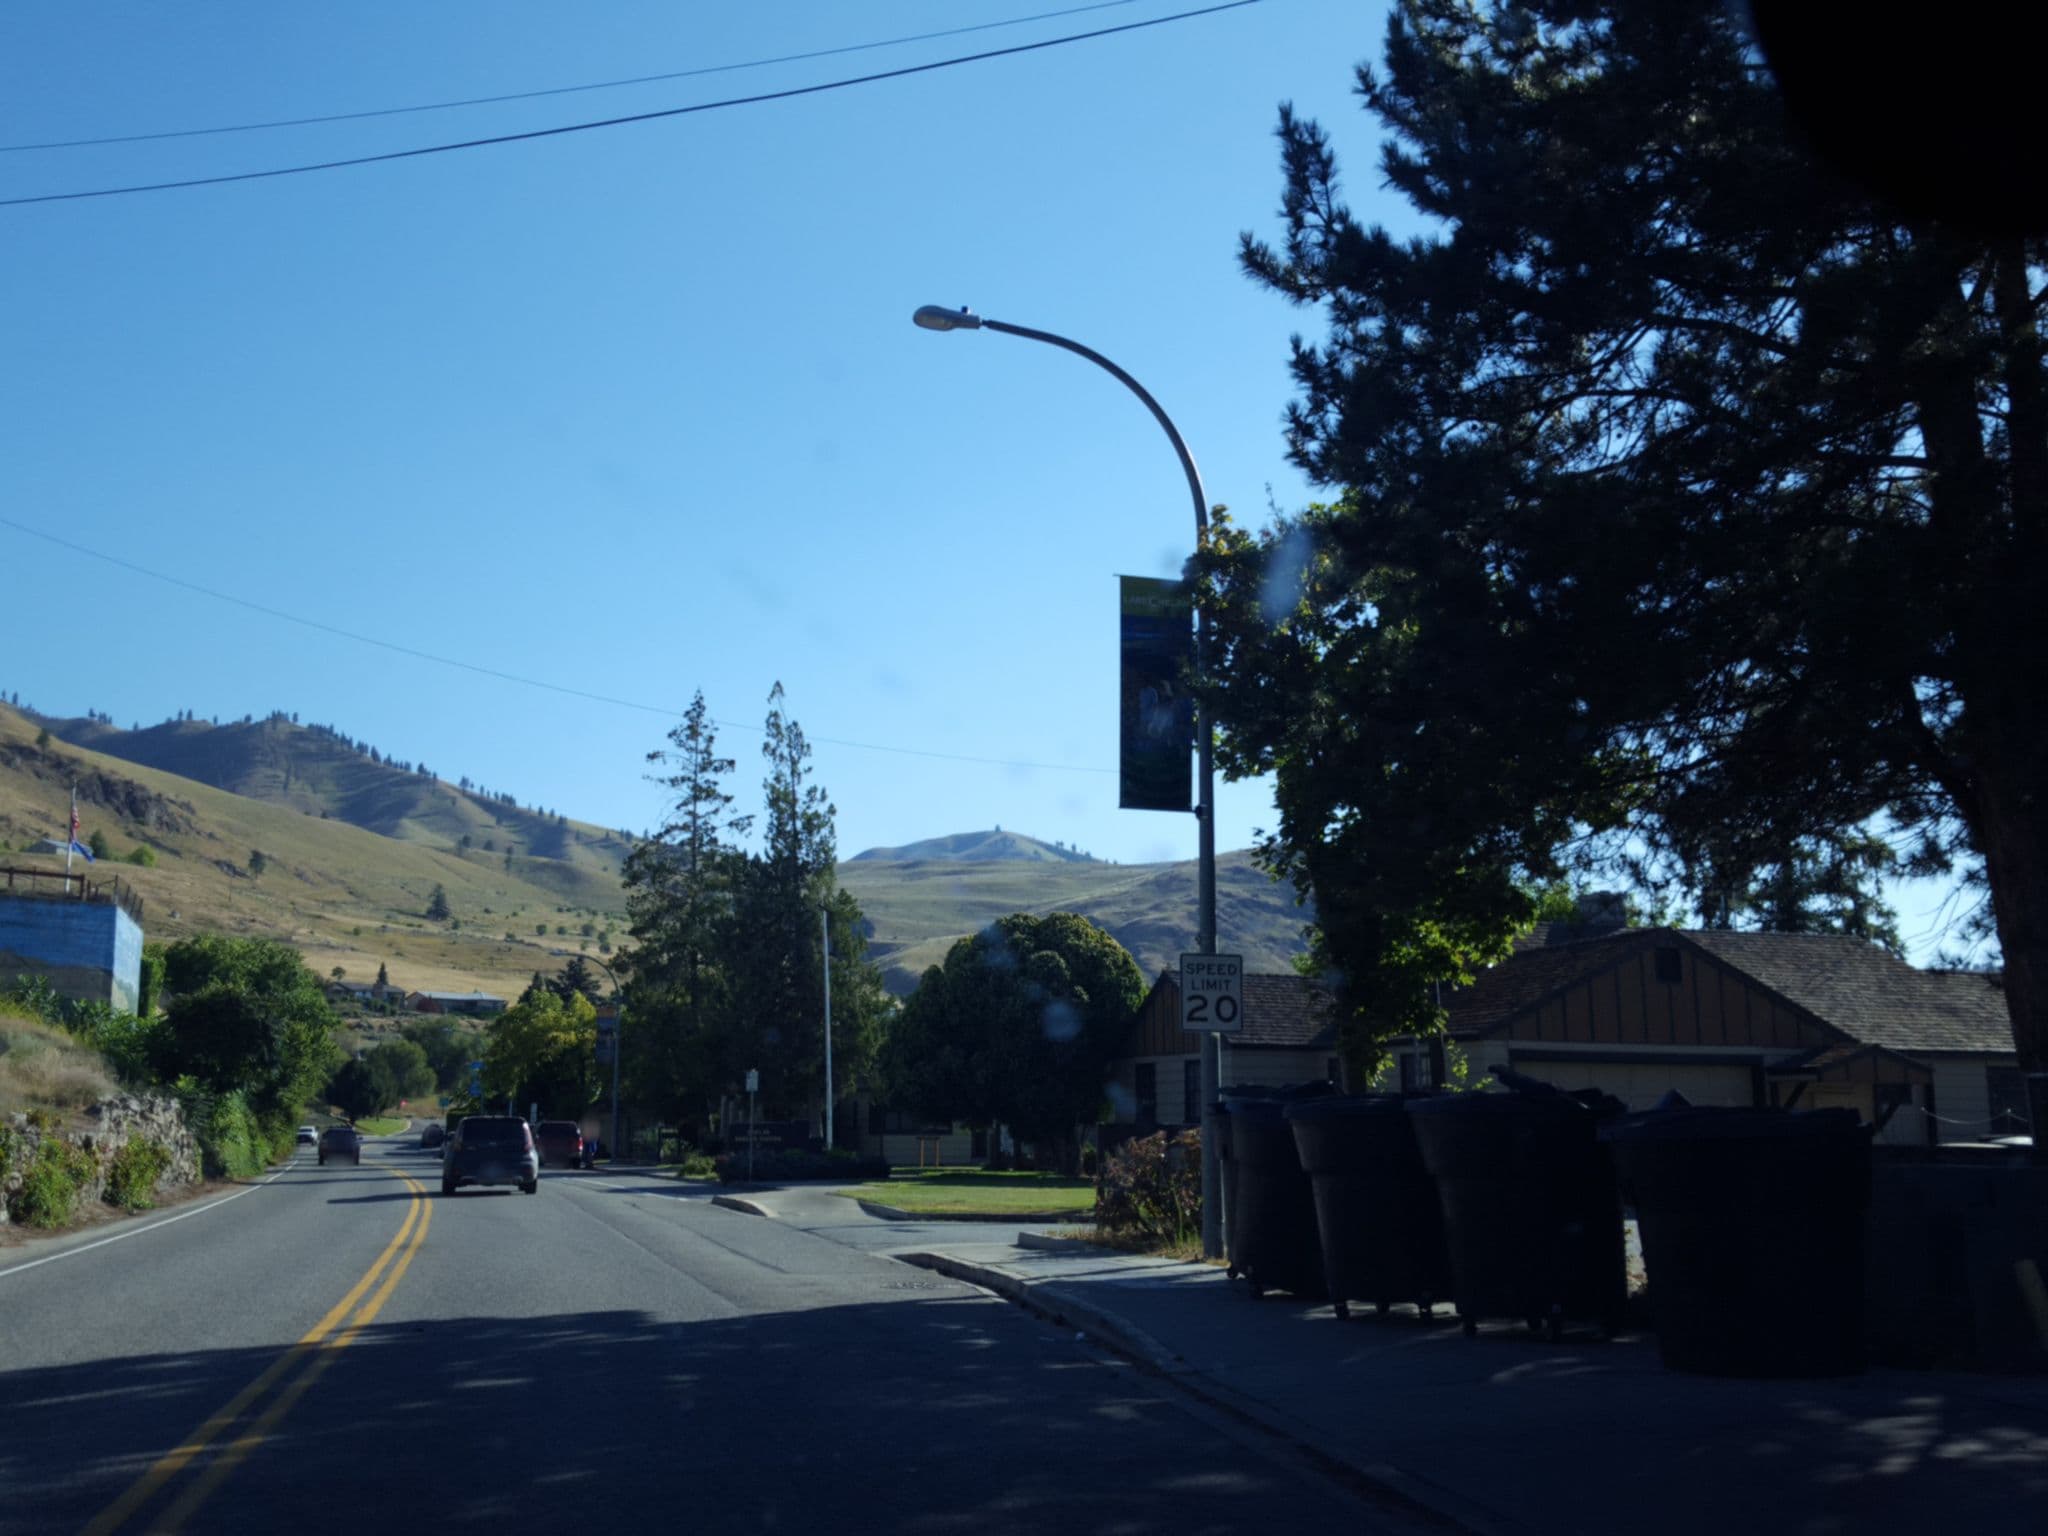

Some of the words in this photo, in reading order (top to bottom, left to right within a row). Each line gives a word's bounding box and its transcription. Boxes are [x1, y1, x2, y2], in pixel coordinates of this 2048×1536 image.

[1185, 963, 1238, 975] SPEED
[1191, 978, 1232, 990] LIMIT
[1187, 995, 1238, 1023] 20
